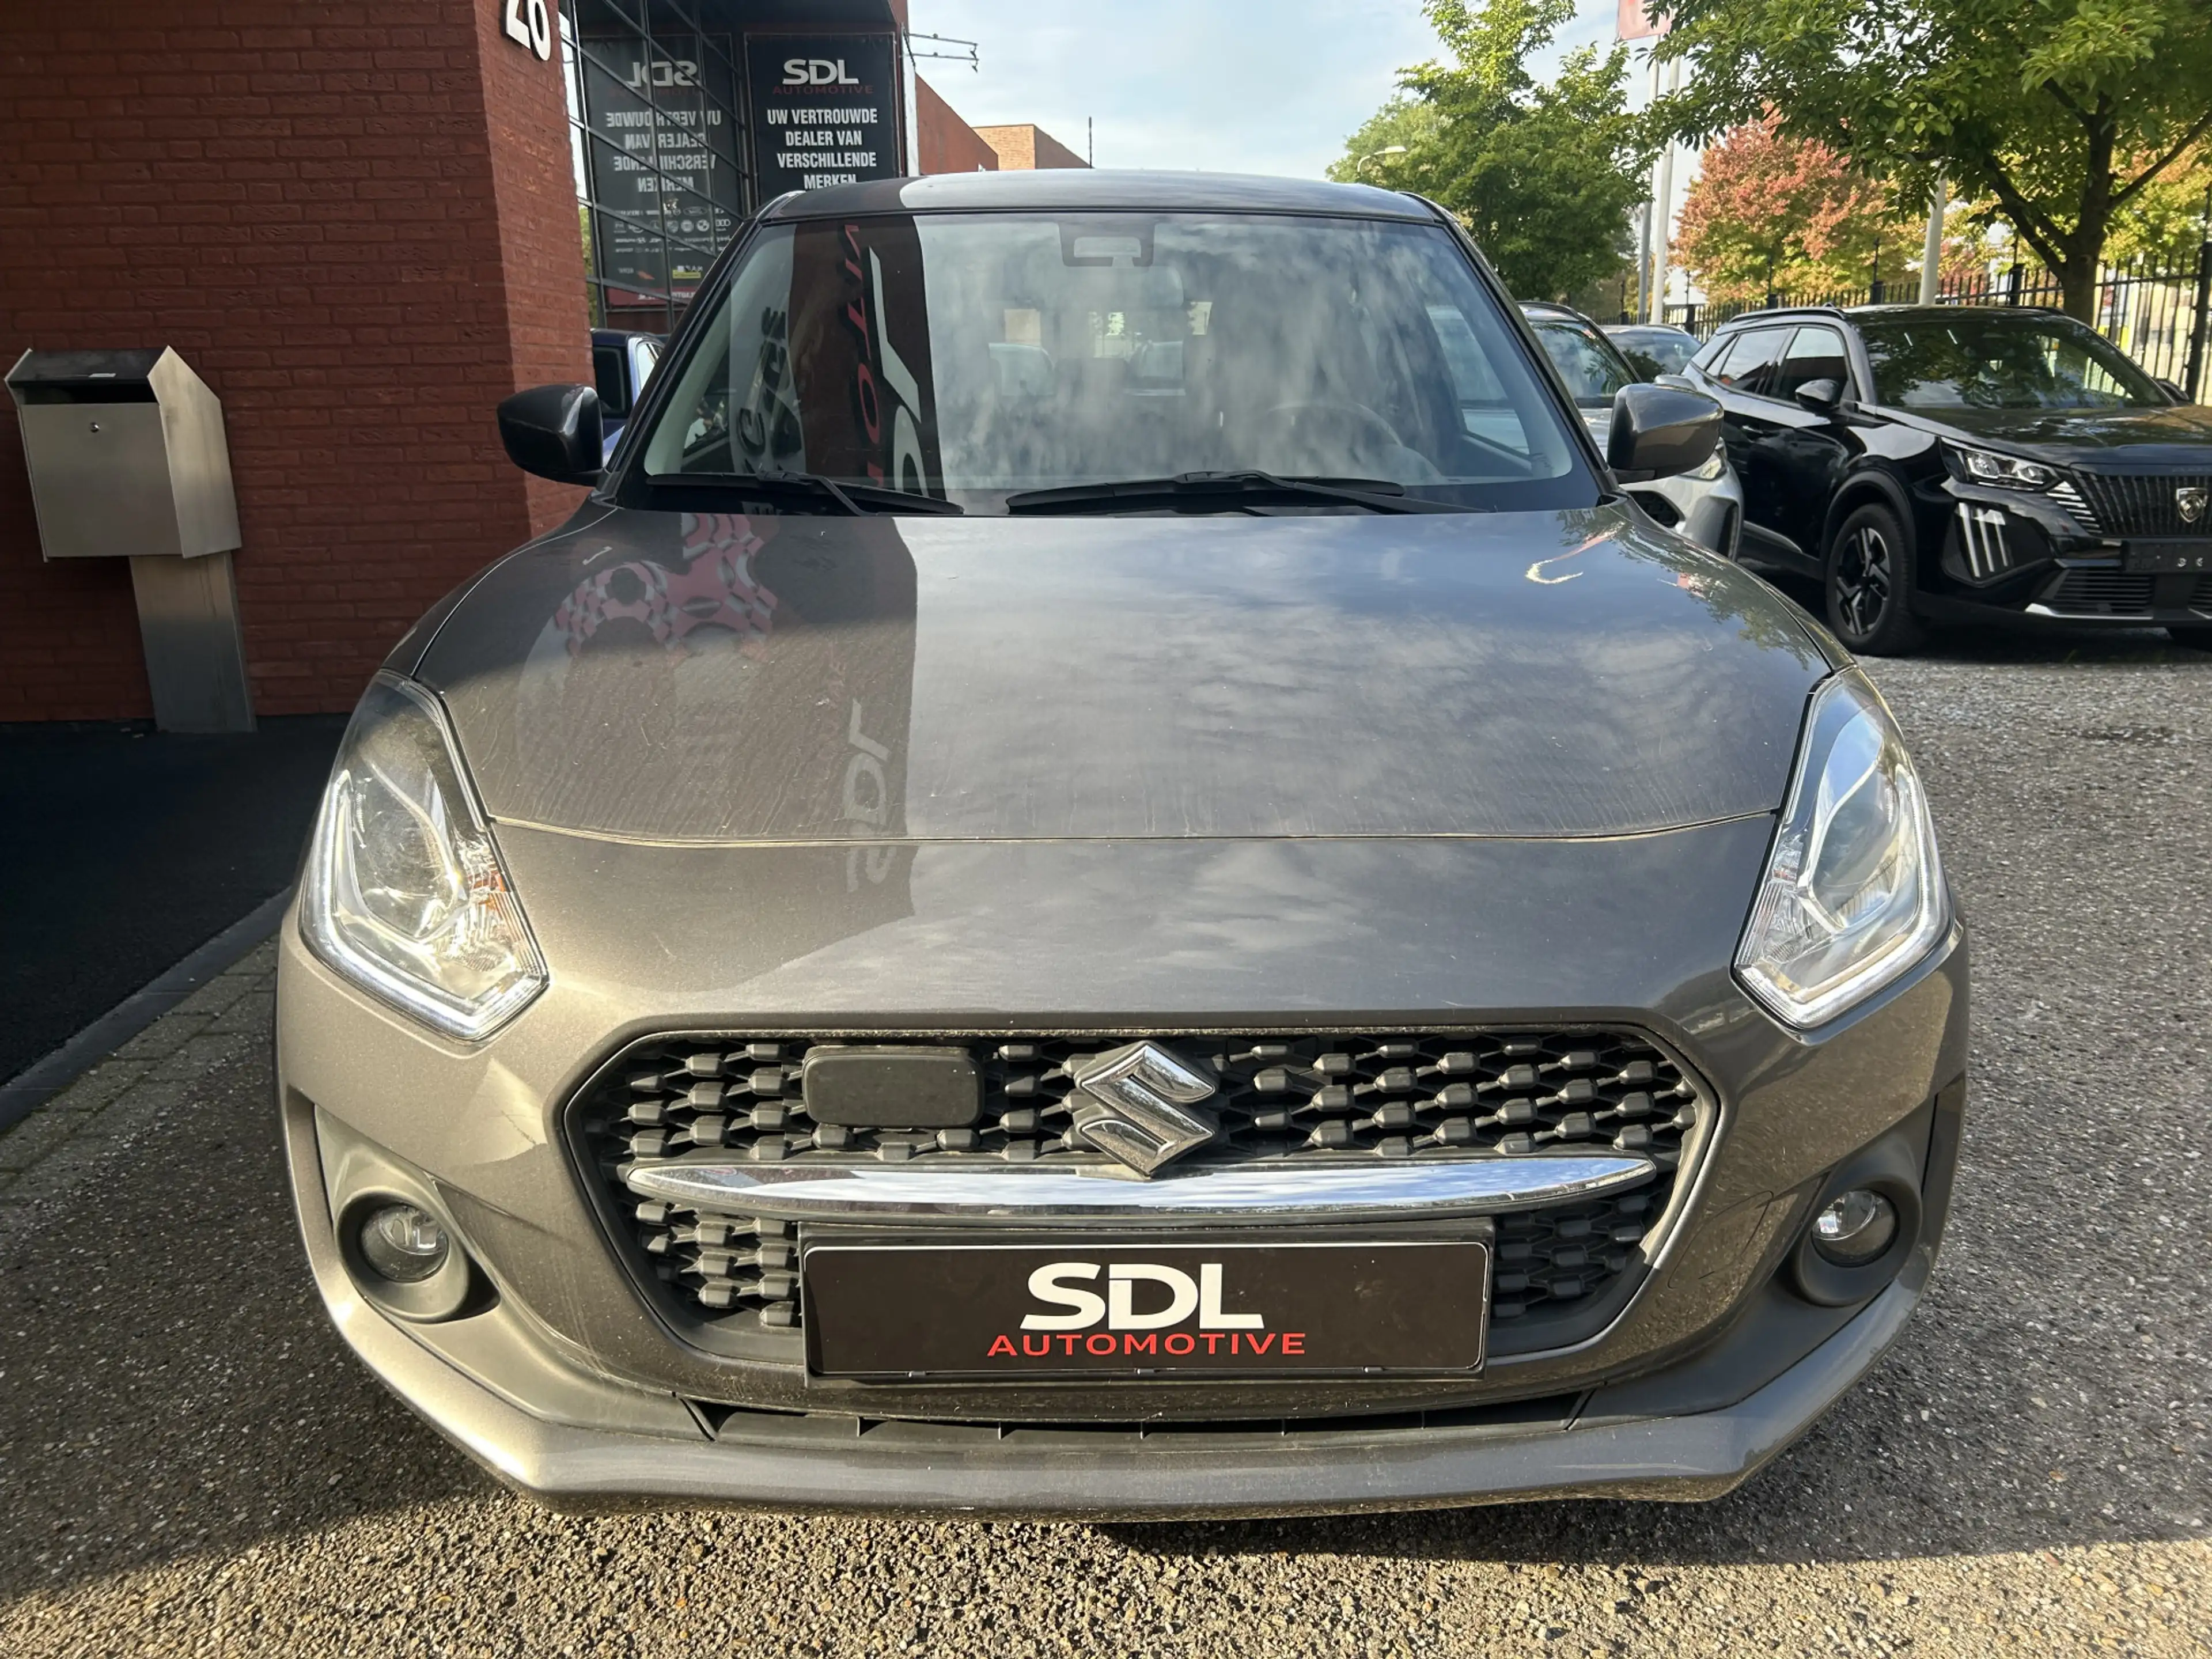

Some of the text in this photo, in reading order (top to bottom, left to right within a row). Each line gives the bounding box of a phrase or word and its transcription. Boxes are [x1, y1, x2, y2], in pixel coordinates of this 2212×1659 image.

[782, 59, 859, 85] SDL
[772, 85, 874, 95] AUTOMOTIVE
[767, 108, 878, 124] UW VERTROUWDE
[785, 130, 863, 146] DEALER VAN
[777, 151, 877, 168] VERSCHILLENDE
[804, 173, 857, 190] MERKEN
[1020, 1262, 1265, 1331] SDL
[987, 1332, 1306, 1358] AUTOMOTIVE
